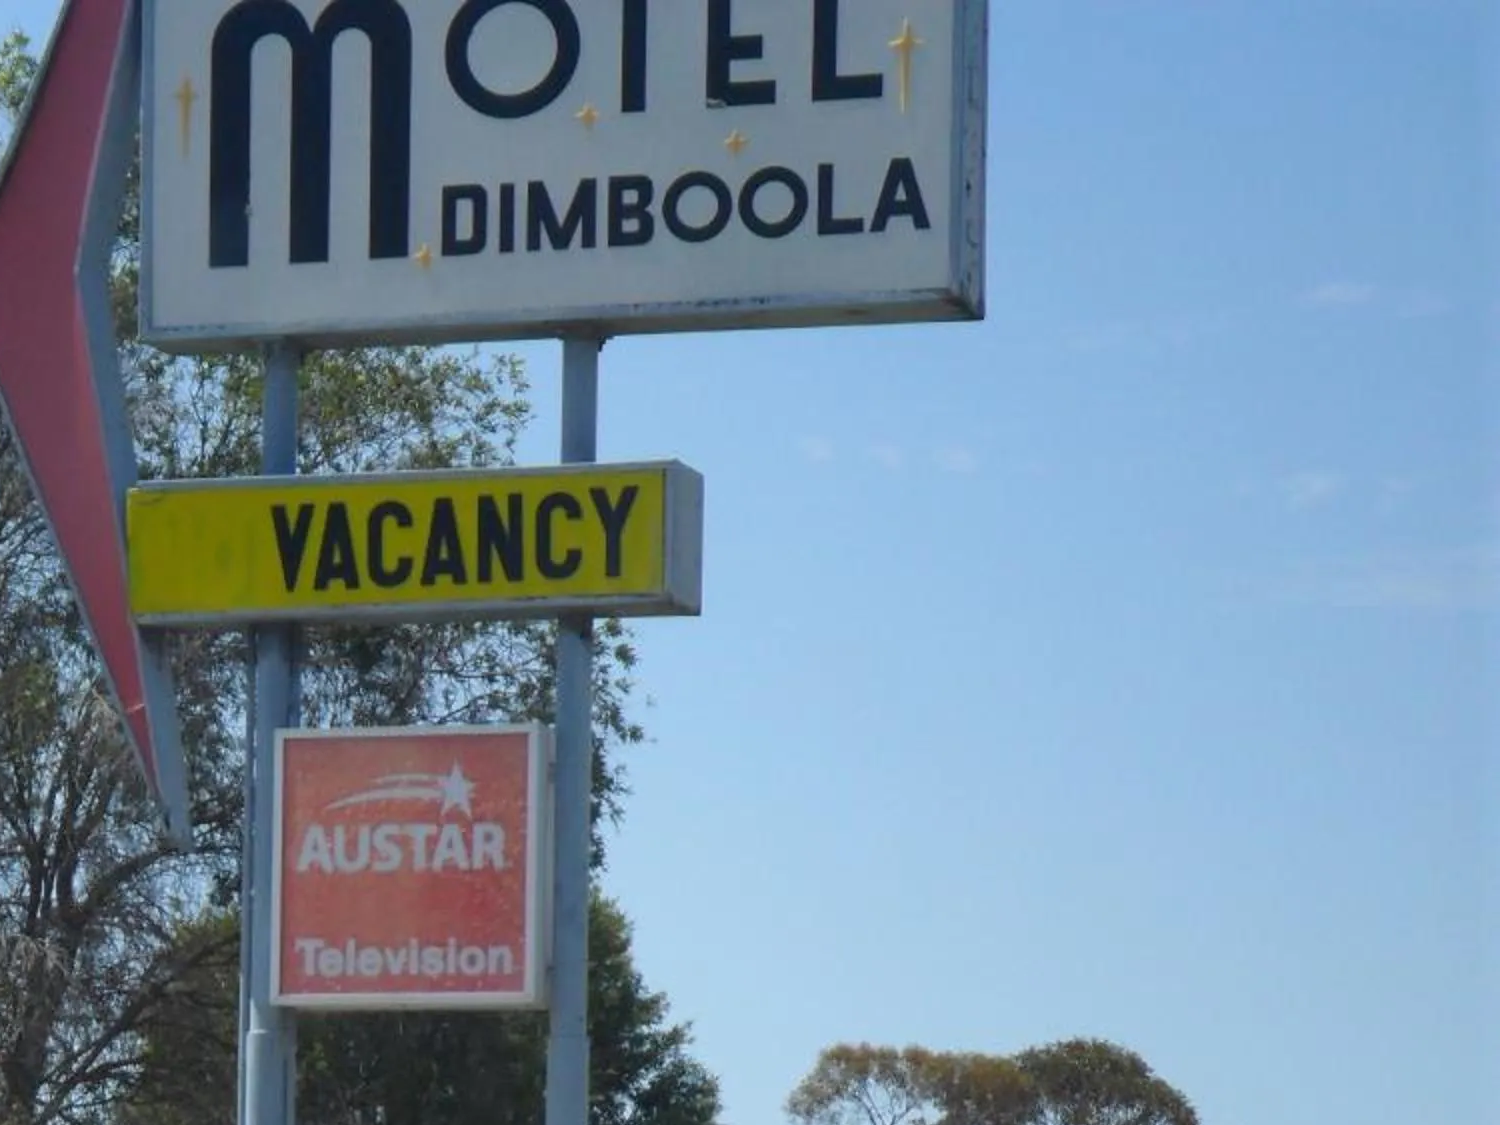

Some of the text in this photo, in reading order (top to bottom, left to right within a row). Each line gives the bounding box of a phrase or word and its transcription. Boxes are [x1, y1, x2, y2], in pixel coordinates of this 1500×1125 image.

[440, 157, 931, 257] DIMBOOLA
[271, 485, 640, 593] VACANCY
[297, 822, 506, 873] AUSTAR
[296, 937, 513, 978] Television
